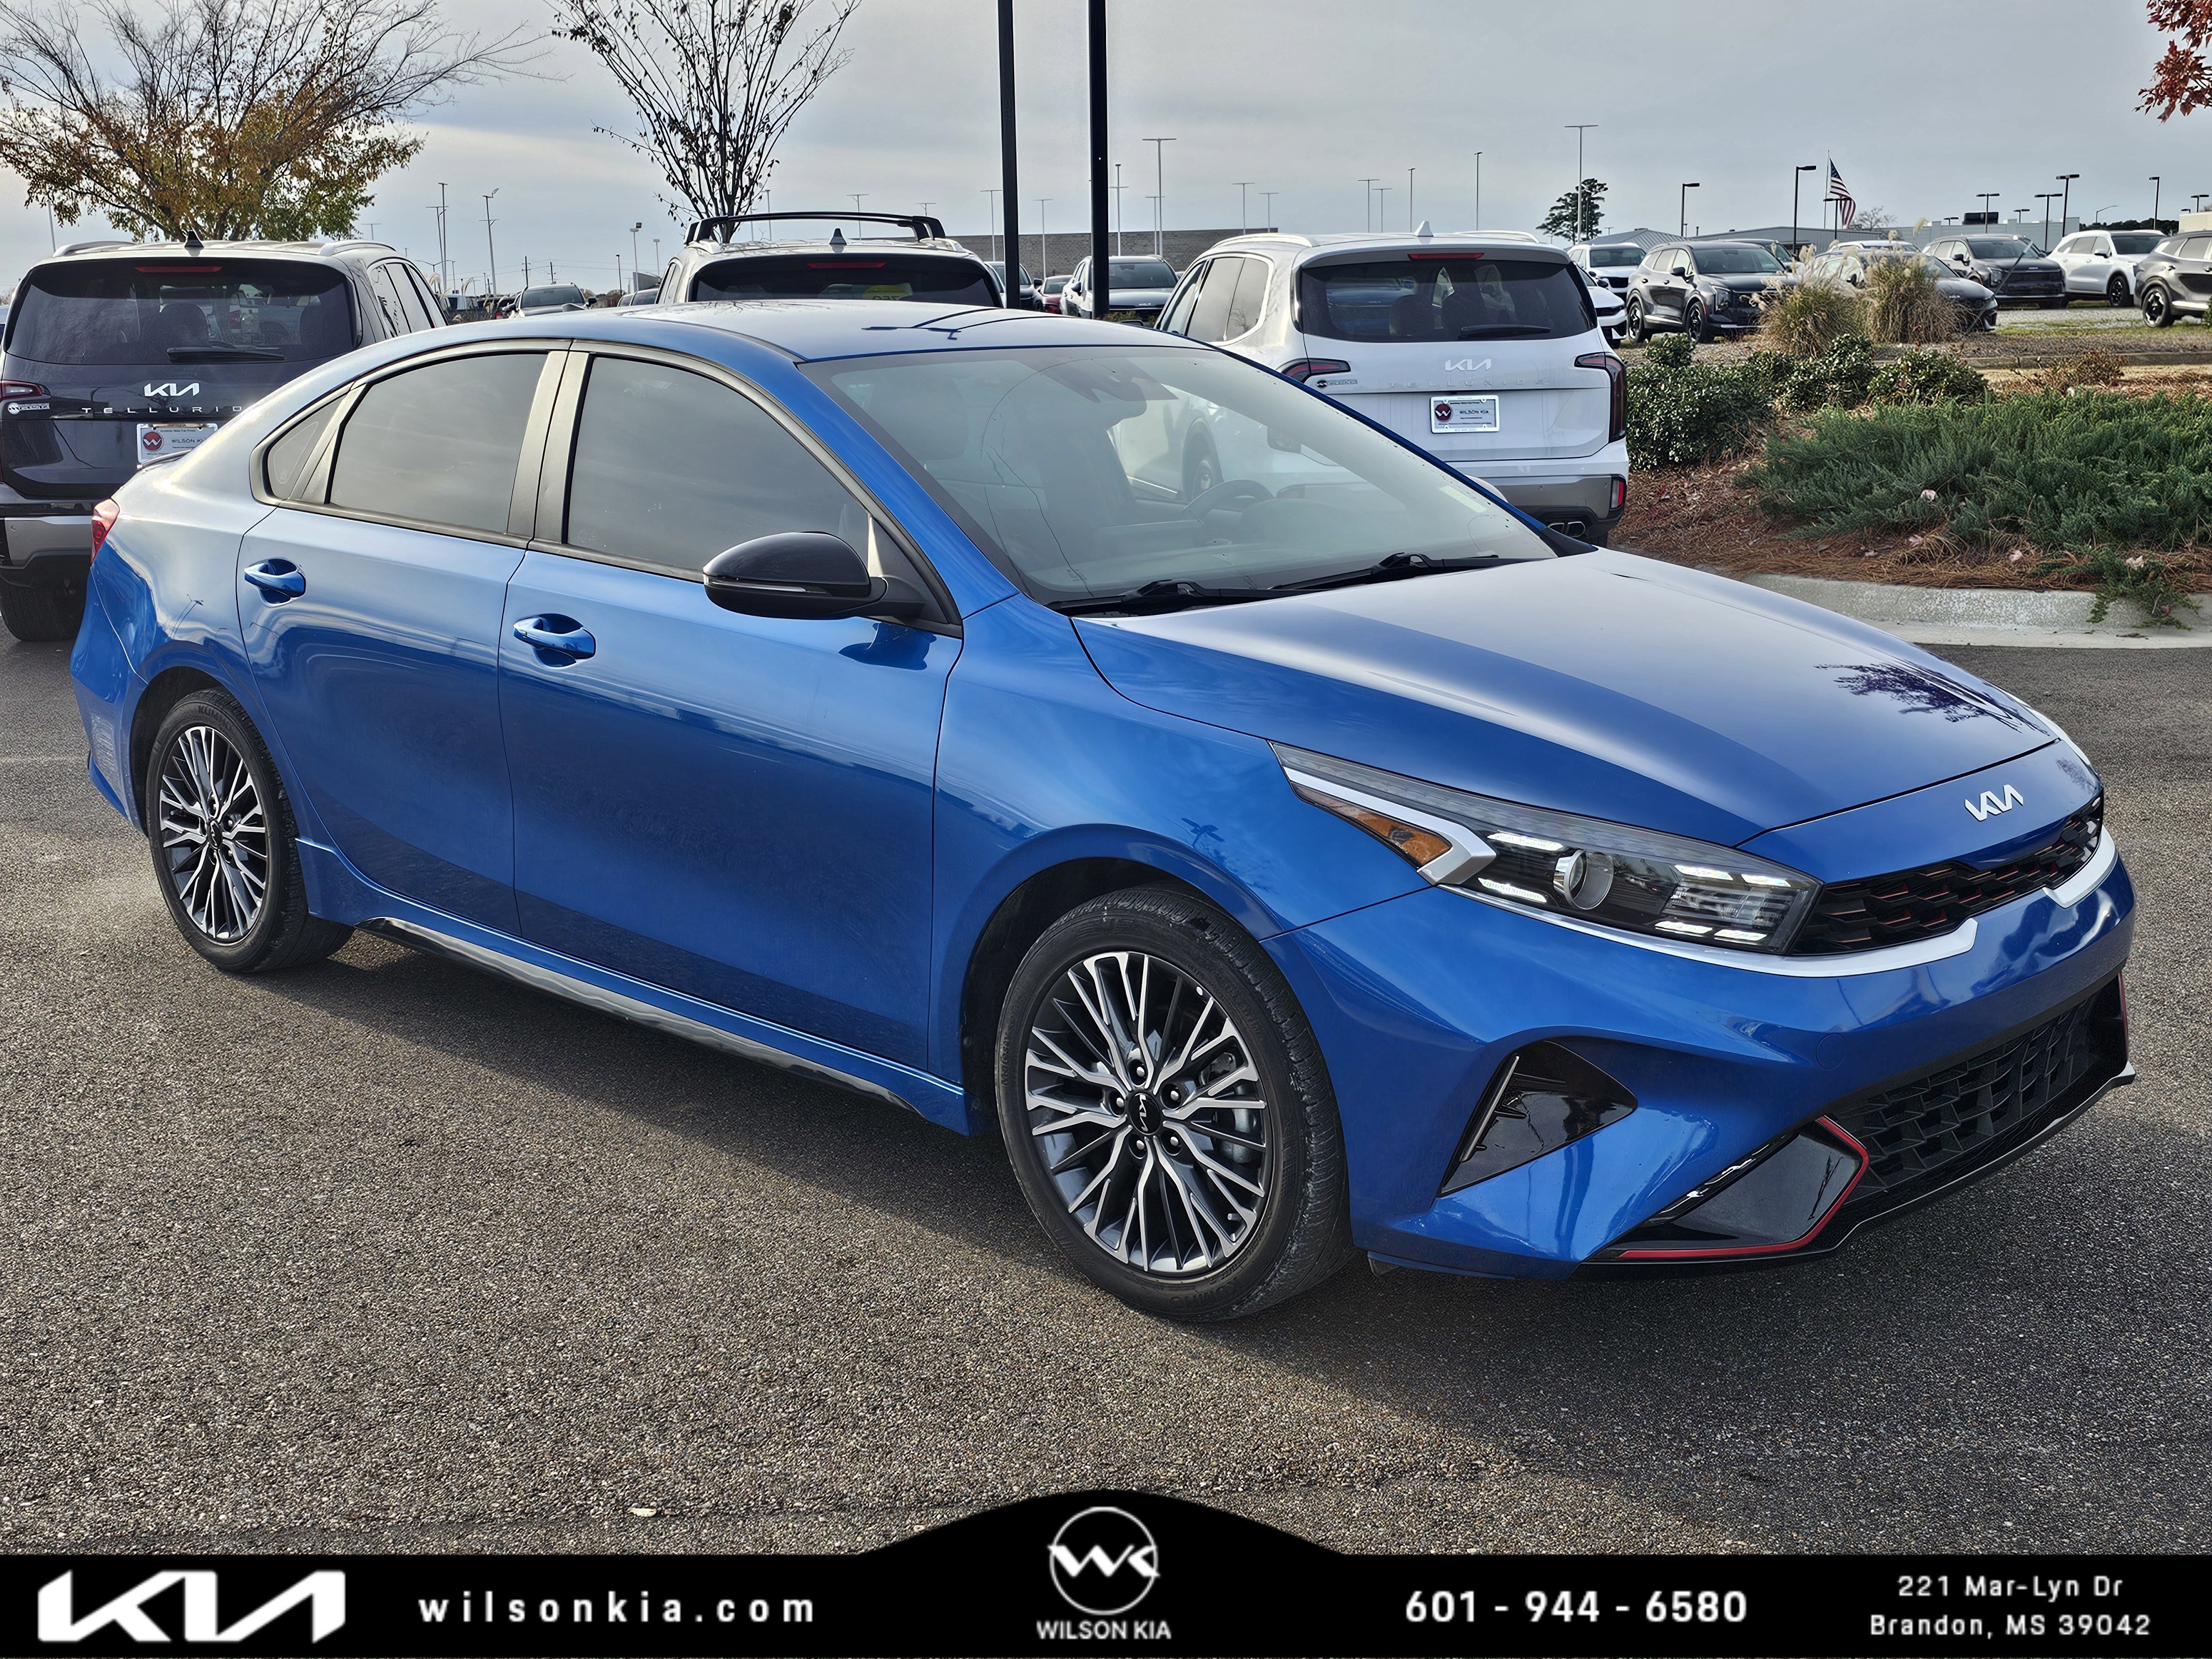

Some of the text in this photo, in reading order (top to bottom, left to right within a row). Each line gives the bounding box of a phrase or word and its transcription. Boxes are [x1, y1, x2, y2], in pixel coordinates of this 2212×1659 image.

[1445, 359, 1491, 371] KIA
[144, 383, 200, 397] KIA
[1965, 784, 2023, 822] KIA
